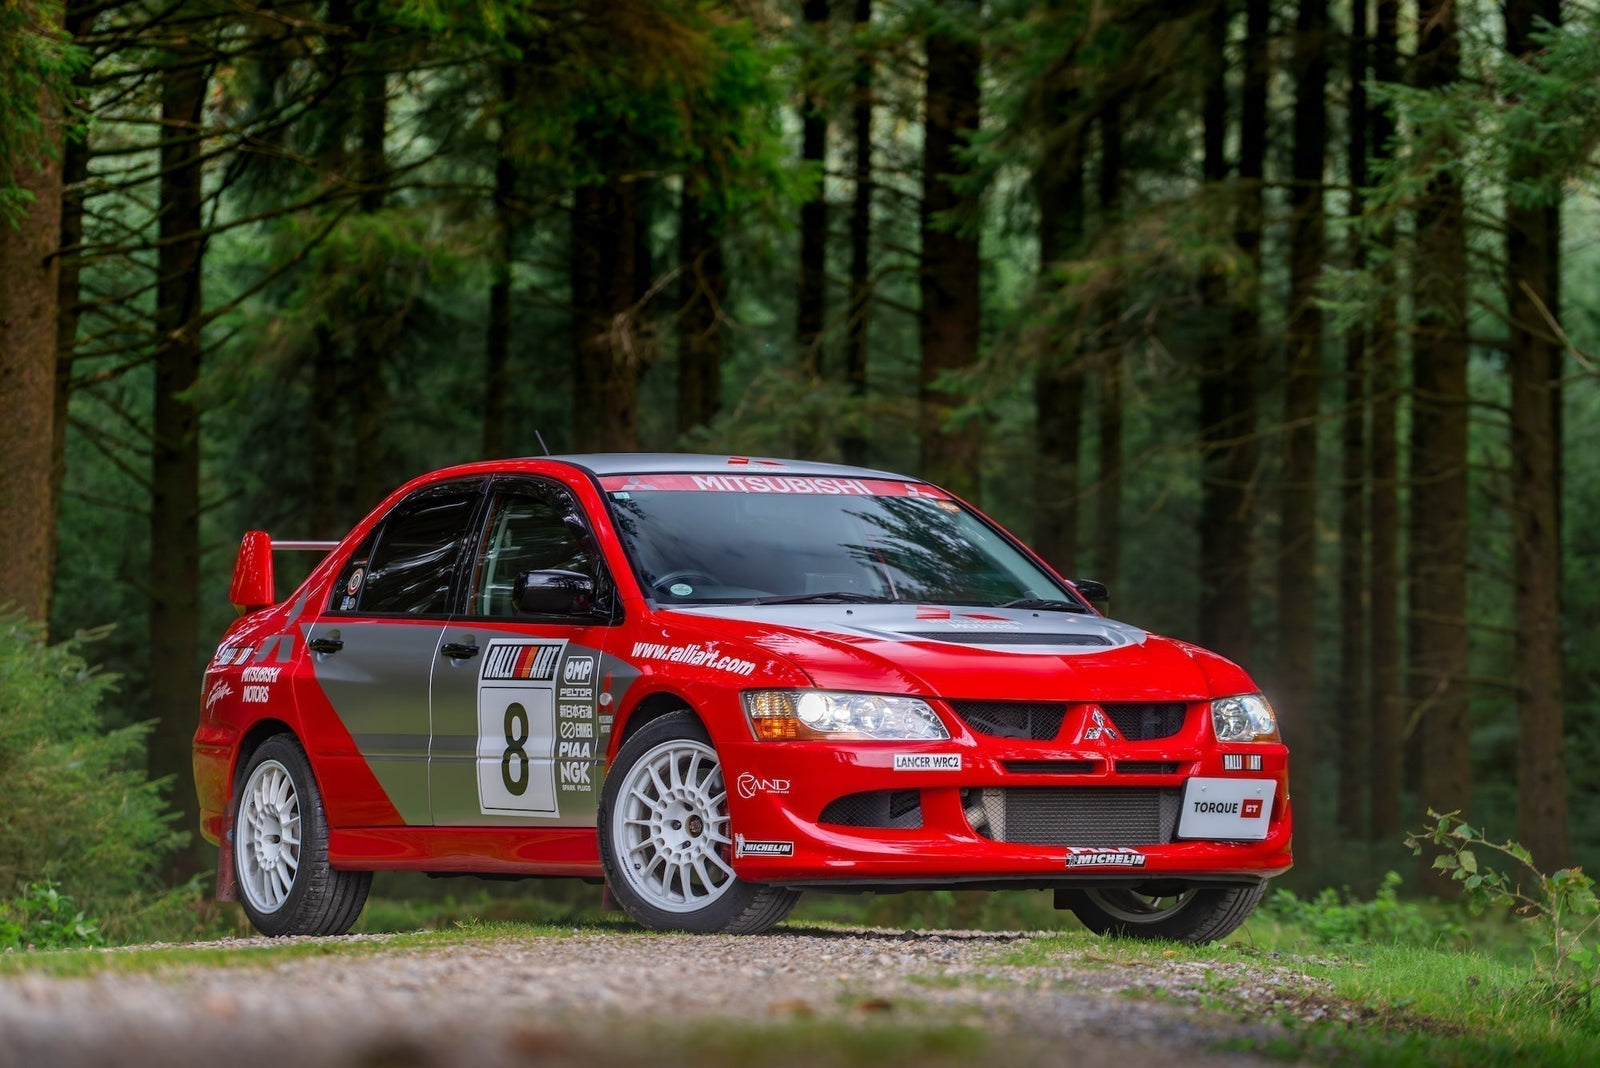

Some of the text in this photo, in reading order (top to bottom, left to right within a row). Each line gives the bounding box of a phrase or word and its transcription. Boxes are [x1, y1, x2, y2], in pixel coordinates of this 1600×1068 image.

[690, 475, 874, 495] MITSUBISHI
[631, 641, 757, 676] www.ralliart.com
[565, 661, 592, 680] OMP
[242, 686, 270, 702] MOTORS
[560, 688, 593, 697] PELTOR
[501, 702, 529, 797] 8
[559, 741, 591, 758] PIAA
[896, 756, 959, 768] LANCER WRC2
[560, 761, 591, 784] NGK
[1194, 801, 1259, 814] TORQUE GT
[744, 843, 792, 852] MICHELIN
[1076, 853, 1146, 865] MICHELIN
